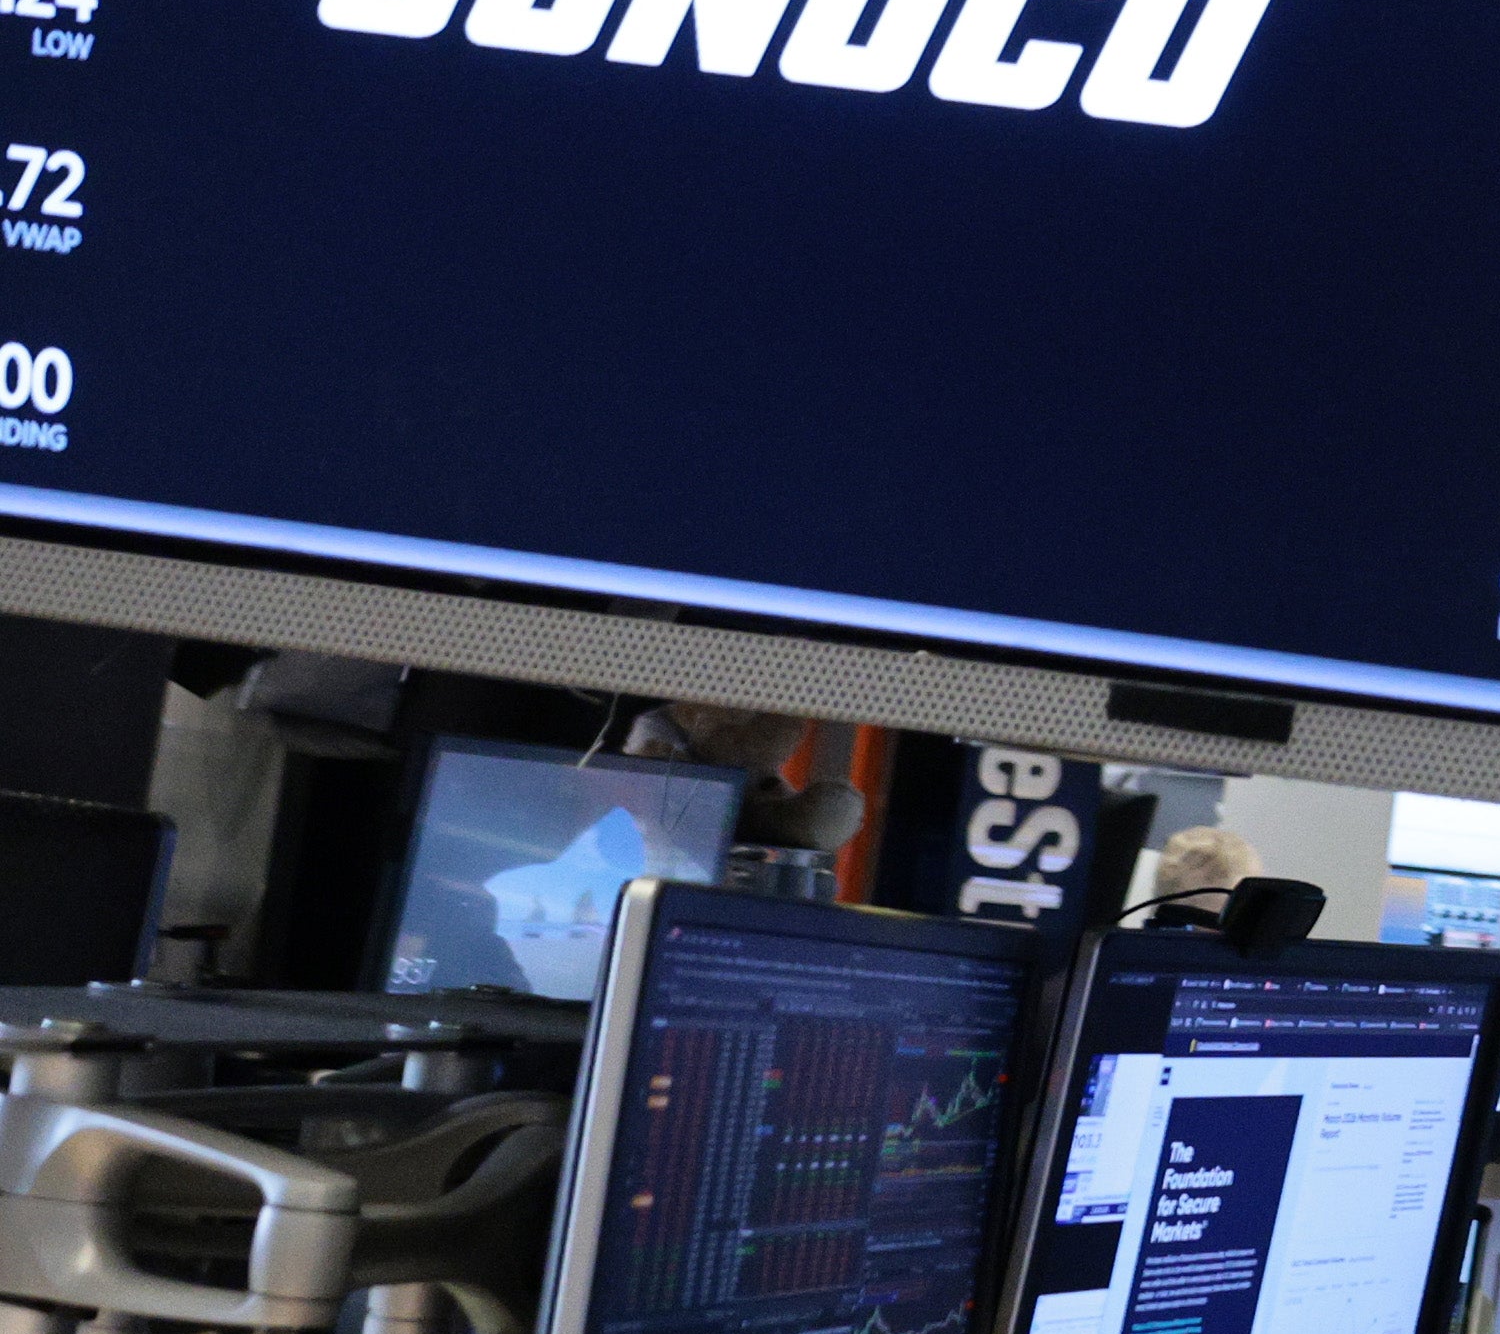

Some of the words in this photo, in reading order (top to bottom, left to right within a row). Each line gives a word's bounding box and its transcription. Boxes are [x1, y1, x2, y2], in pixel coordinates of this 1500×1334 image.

[31, 27, 95, 60] LOW
[0, 143, 86, 219] 72
[2, 219, 82, 254] VWAP
[1169, 1141, 1195, 1163] The
[1161, 1165, 1234, 1190] Foundation
[1156, 1194, 1178, 1217] for
[1176, 1193, 1222, 1216] Secure
